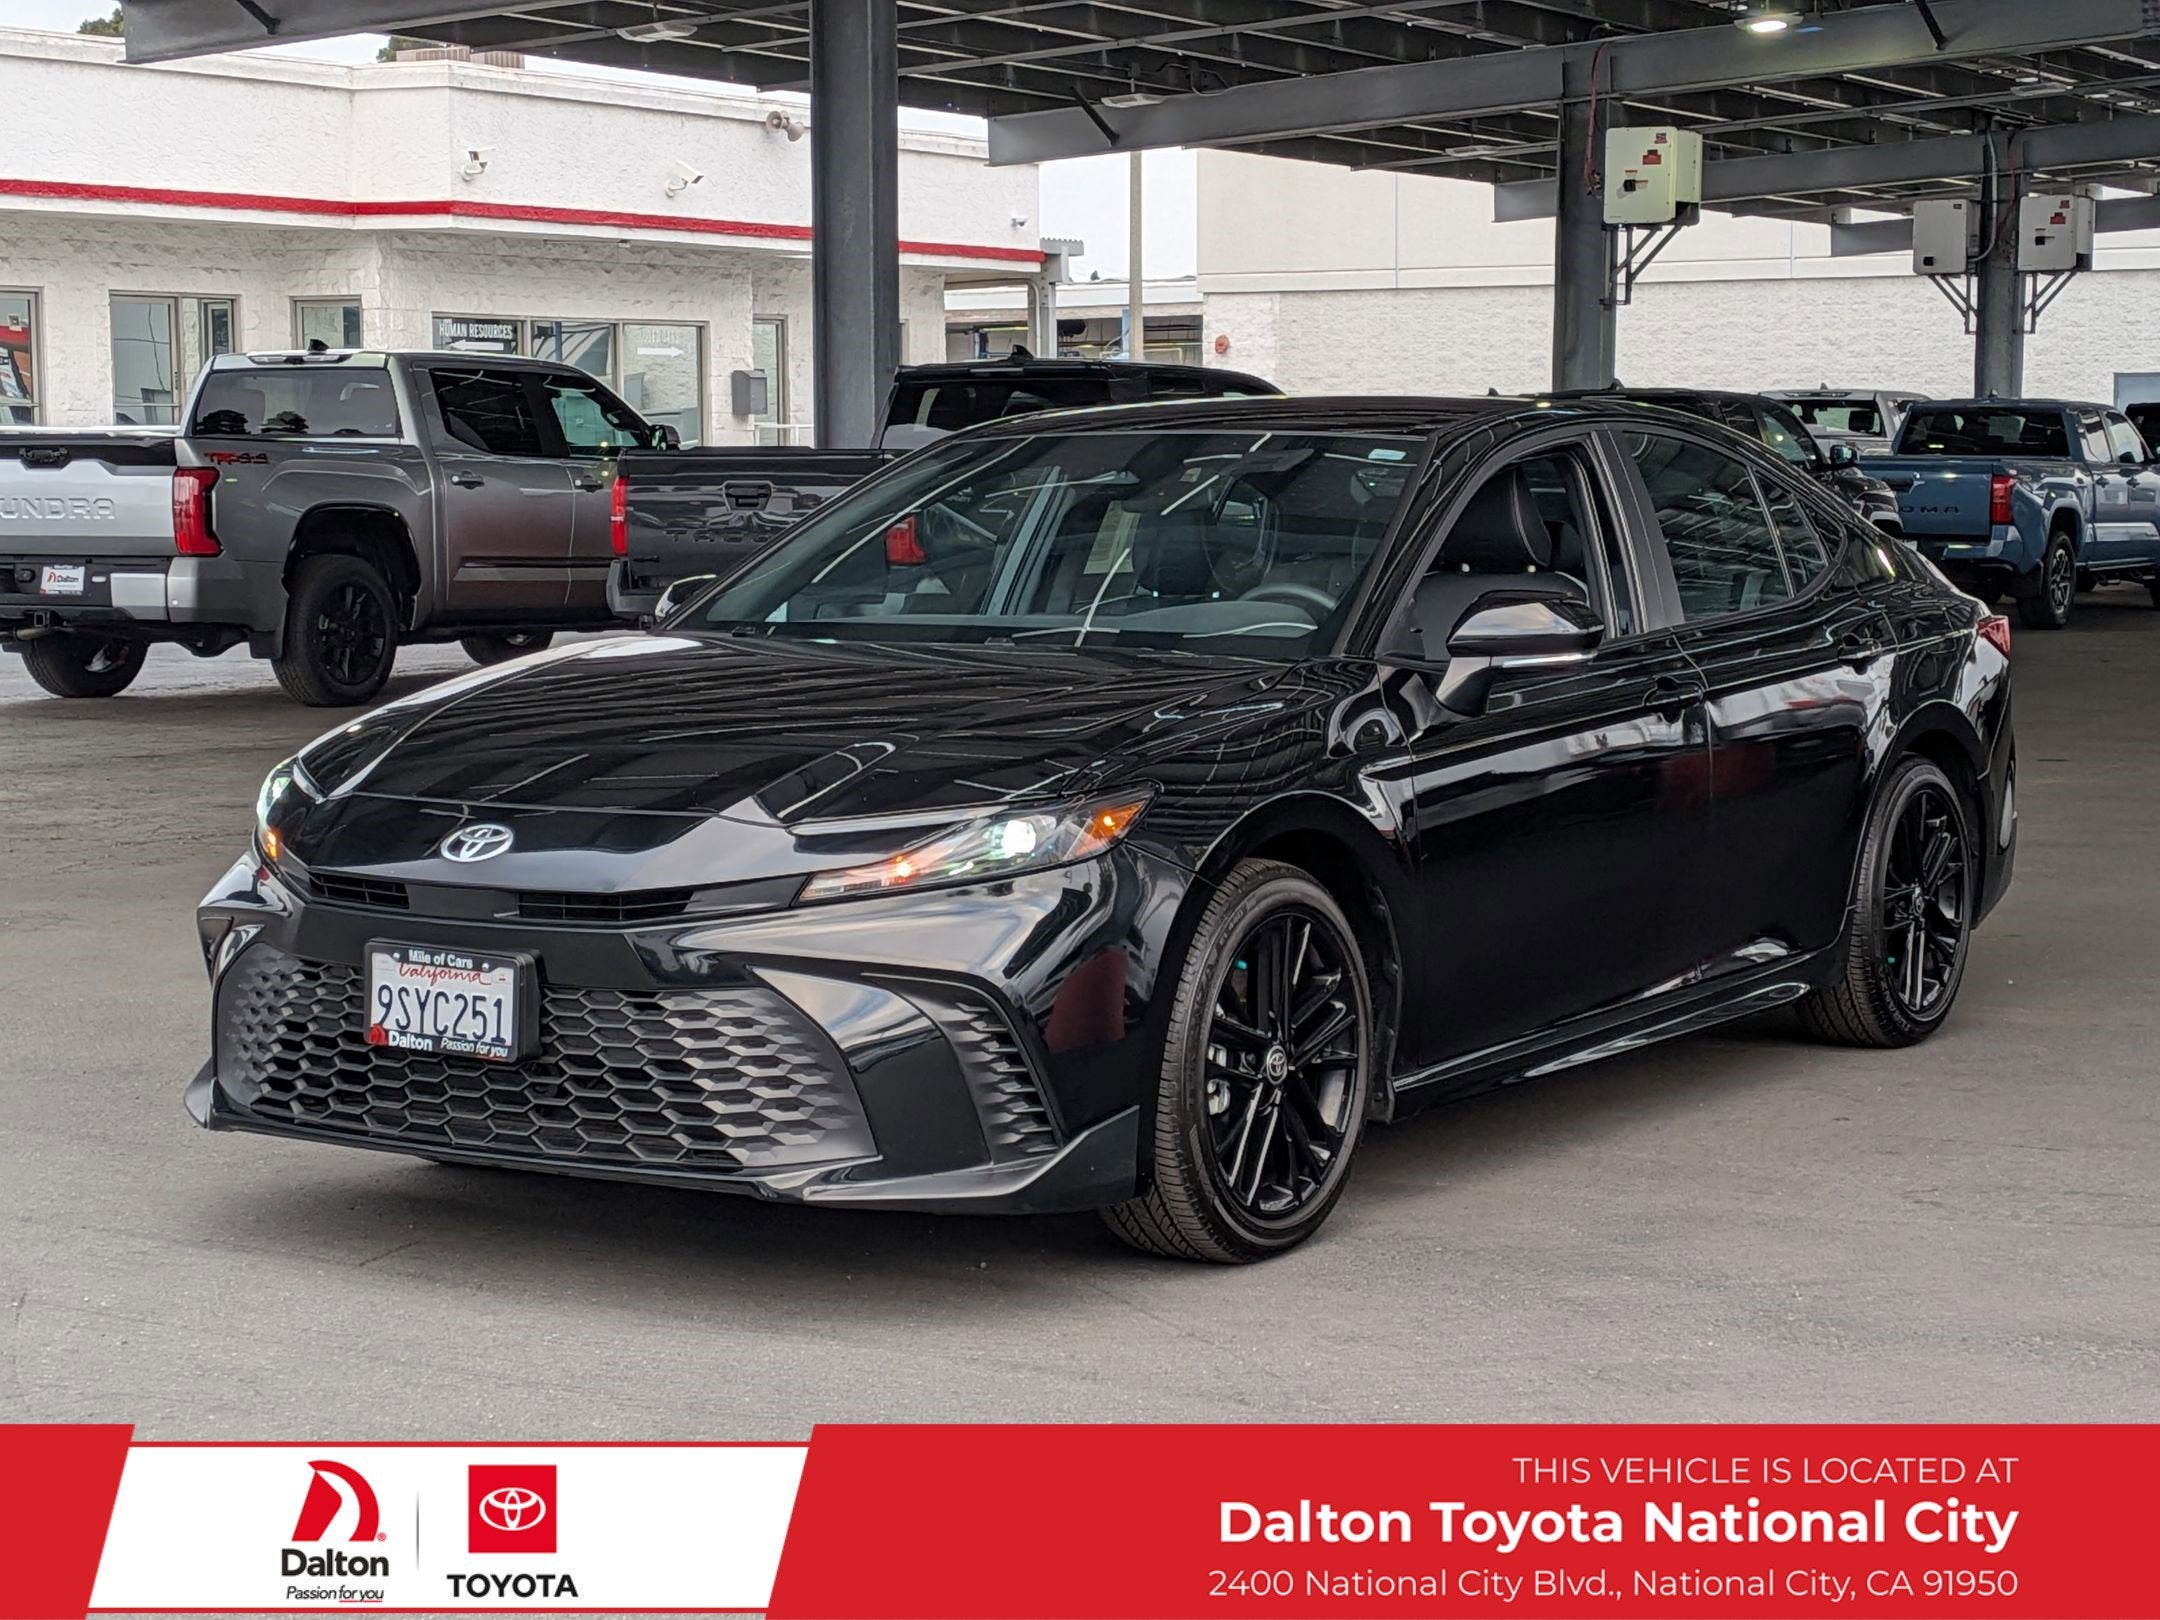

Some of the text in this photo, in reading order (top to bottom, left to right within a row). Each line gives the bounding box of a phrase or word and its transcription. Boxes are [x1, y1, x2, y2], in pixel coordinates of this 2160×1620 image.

[439, 319, 513, 339] HUMAN RESOURCES
[0, 497, 115, 519] UNDRA
[1901, 505, 1959, 514] OMA
[408, 949, 473, 969] Mile of Cars
[399, 961, 491, 987] California
[377, 984, 506, 1044] 9SYC251
[388, 1030, 508, 1058] Dalton Passion for you
